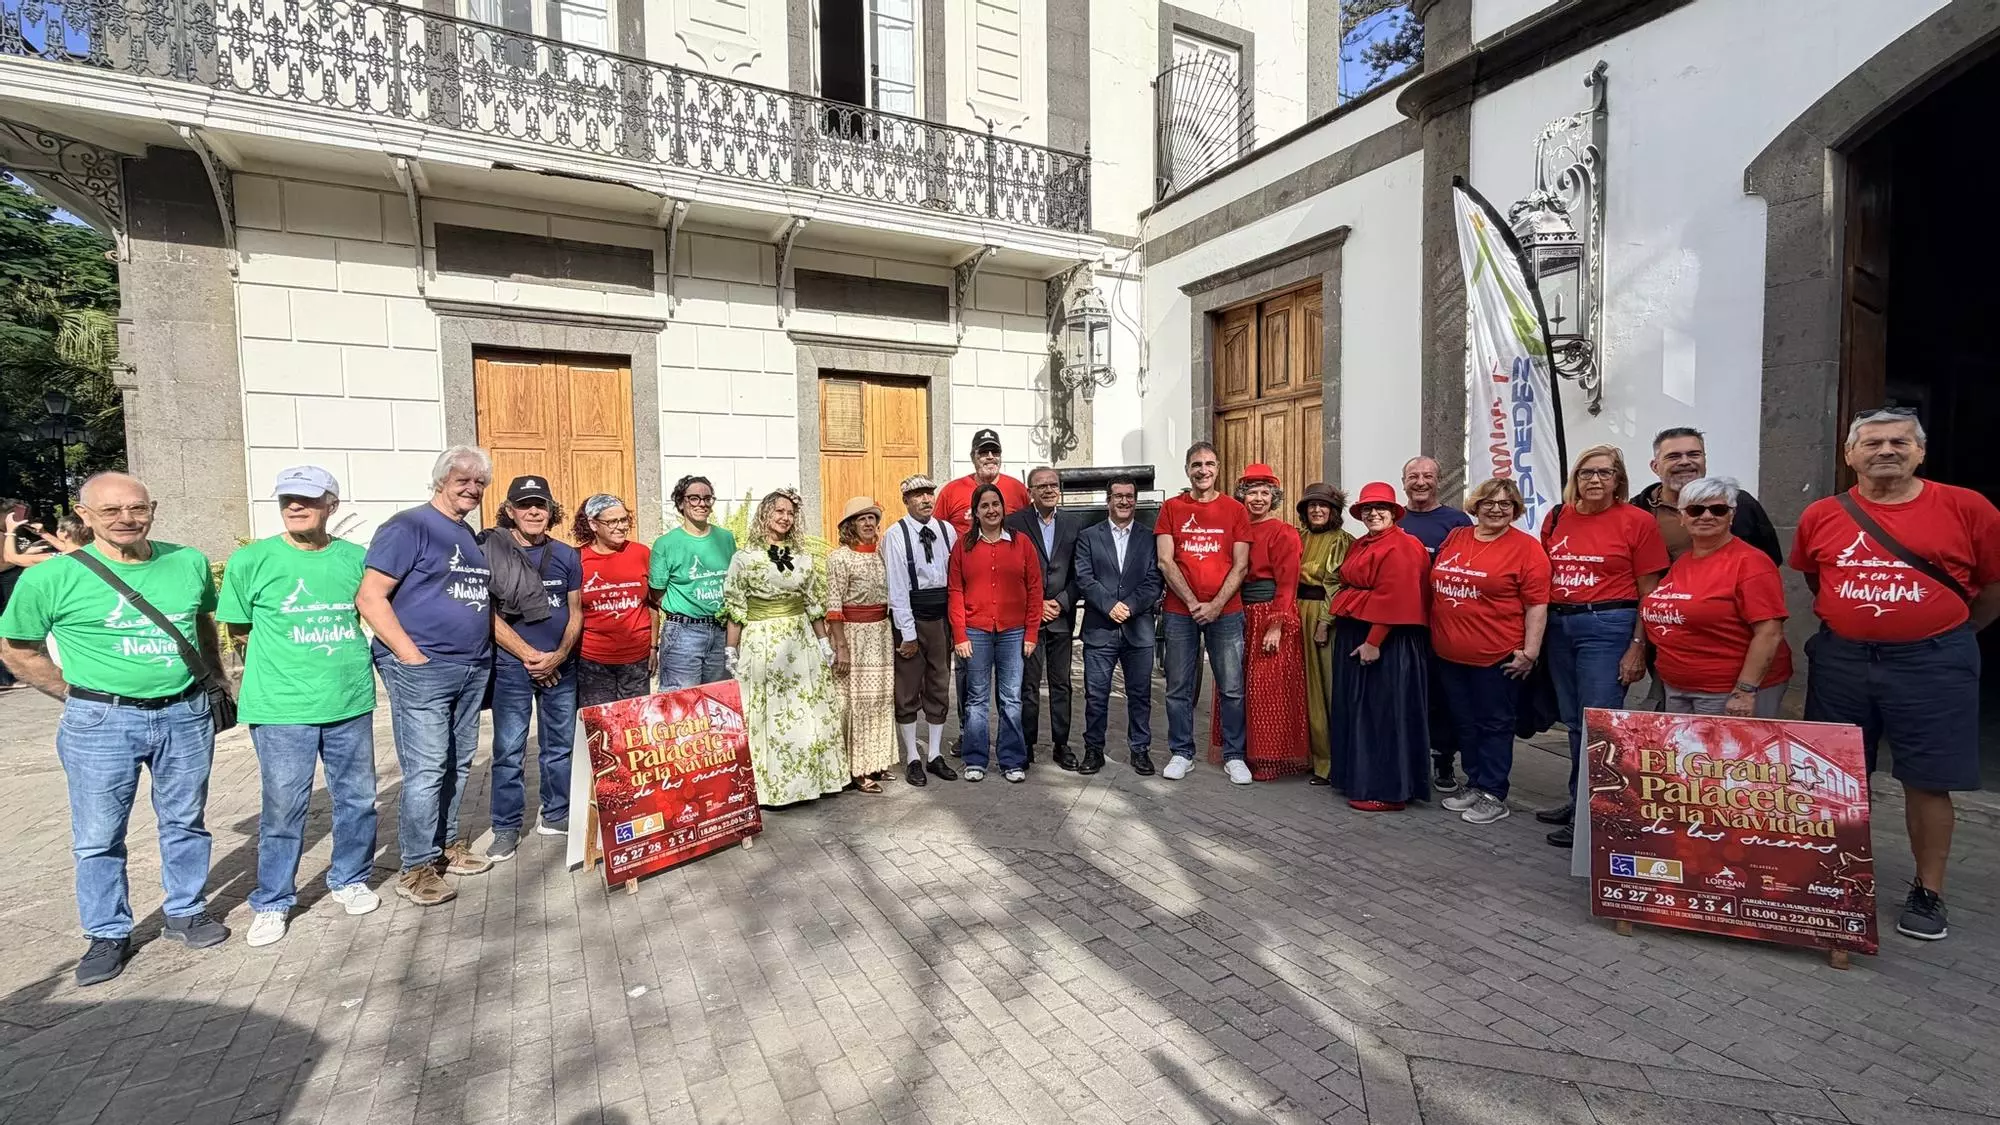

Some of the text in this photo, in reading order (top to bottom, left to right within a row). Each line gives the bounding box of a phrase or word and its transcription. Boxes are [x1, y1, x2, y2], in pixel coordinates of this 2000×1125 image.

[1870, 572, 1891, 581] en
[454, 582, 489, 601] NaVidA
[697, 584, 724, 601] NaVid
[1840, 580, 1921, 603] NaVidAd
[624, 714, 711, 750] El Gran
[627, 733, 725, 772] Palacete
[1640, 749, 1789, 785] El Gran
[631, 747, 737, 788] de la Navidad
[1640, 775, 1815, 816] Palacete
[1640, 801, 1837, 839] de la Navidad
[1641, 816, 1675, 836] de
[1687, 820, 1726, 842] los
[613, 852, 628, 866] 26
[631, 847, 645, 860] 27
[648, 841, 662, 854] 28
[668, 837, 676, 847] 2
[678, 834, 685, 844] 3
[687, 830, 694, 840] 4
[1705, 877, 1746, 889] LOPESAN
[1603, 886, 1732, 915] 26 27 28 2 3 4
[1745, 908, 1778, 920] 18.00
[1789, 913, 1824, 926] 22.00
[1826, 918, 1839, 929] h.
